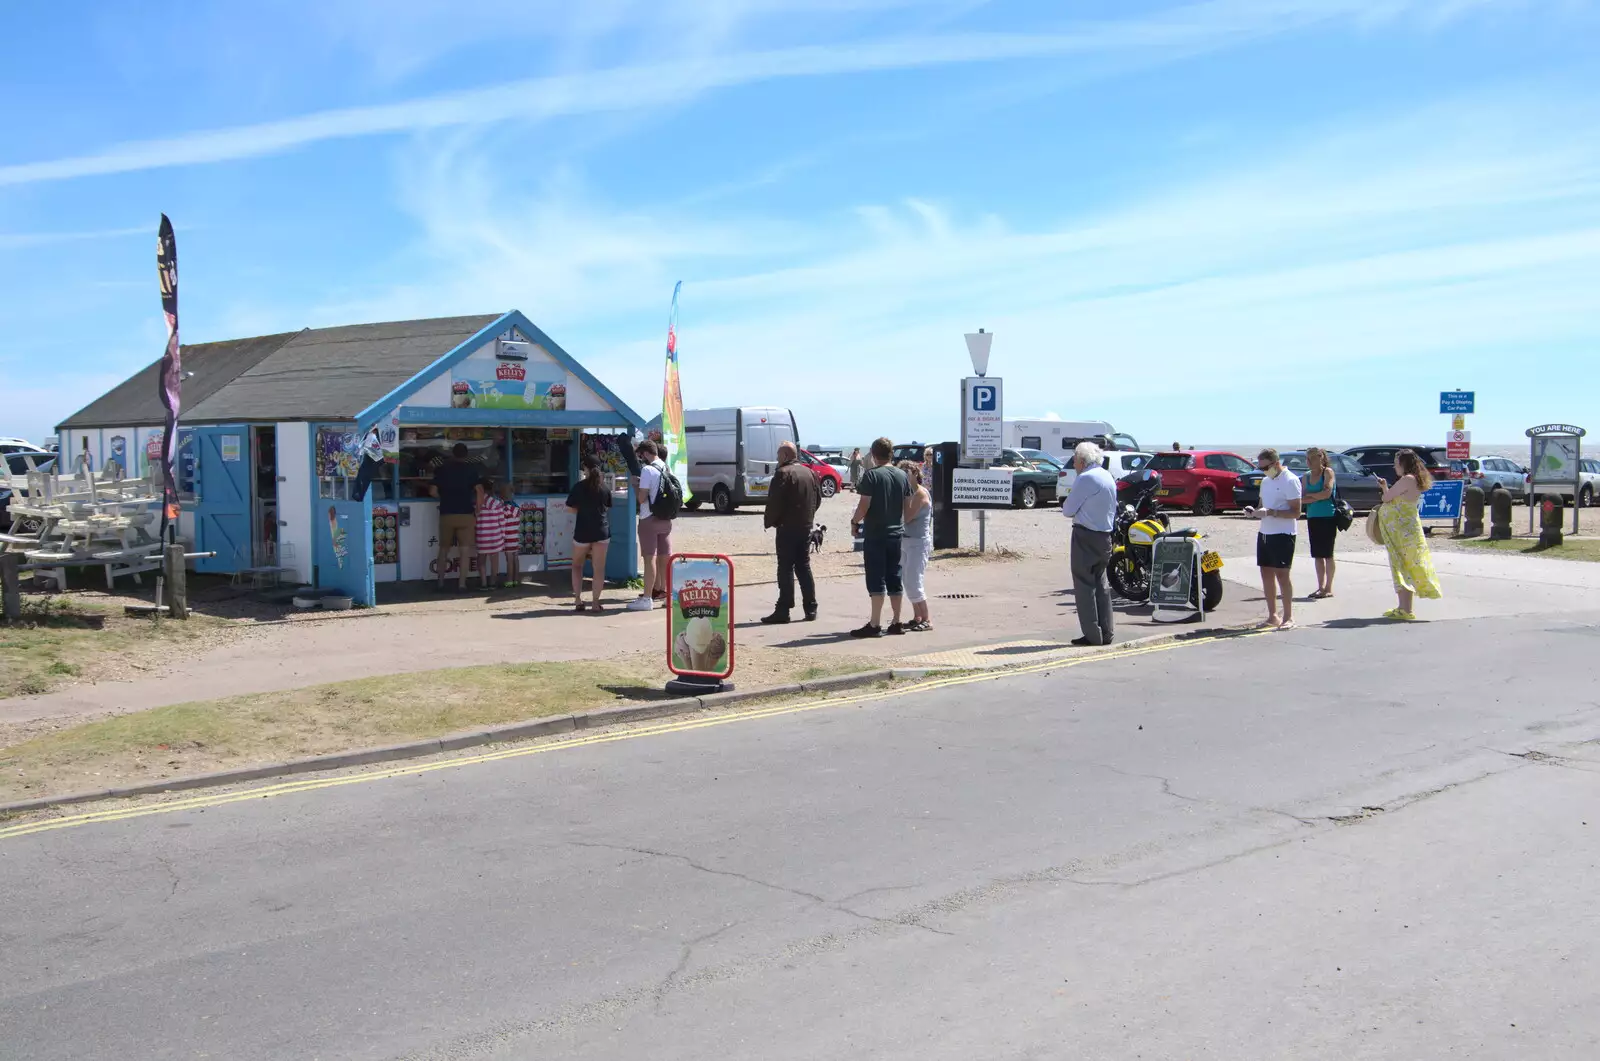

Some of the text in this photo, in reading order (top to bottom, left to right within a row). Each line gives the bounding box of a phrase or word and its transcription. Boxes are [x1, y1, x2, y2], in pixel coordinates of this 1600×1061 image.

[498, 369, 524, 377] KELLY'S
[977, 388, 991, 409] P
[1531, 426, 1546, 434] YOU
[1562, 425, 1581, 434] HERE
[682, 590, 718, 601] KELLY'S
[688, 607, 715, 616] Sold Here
